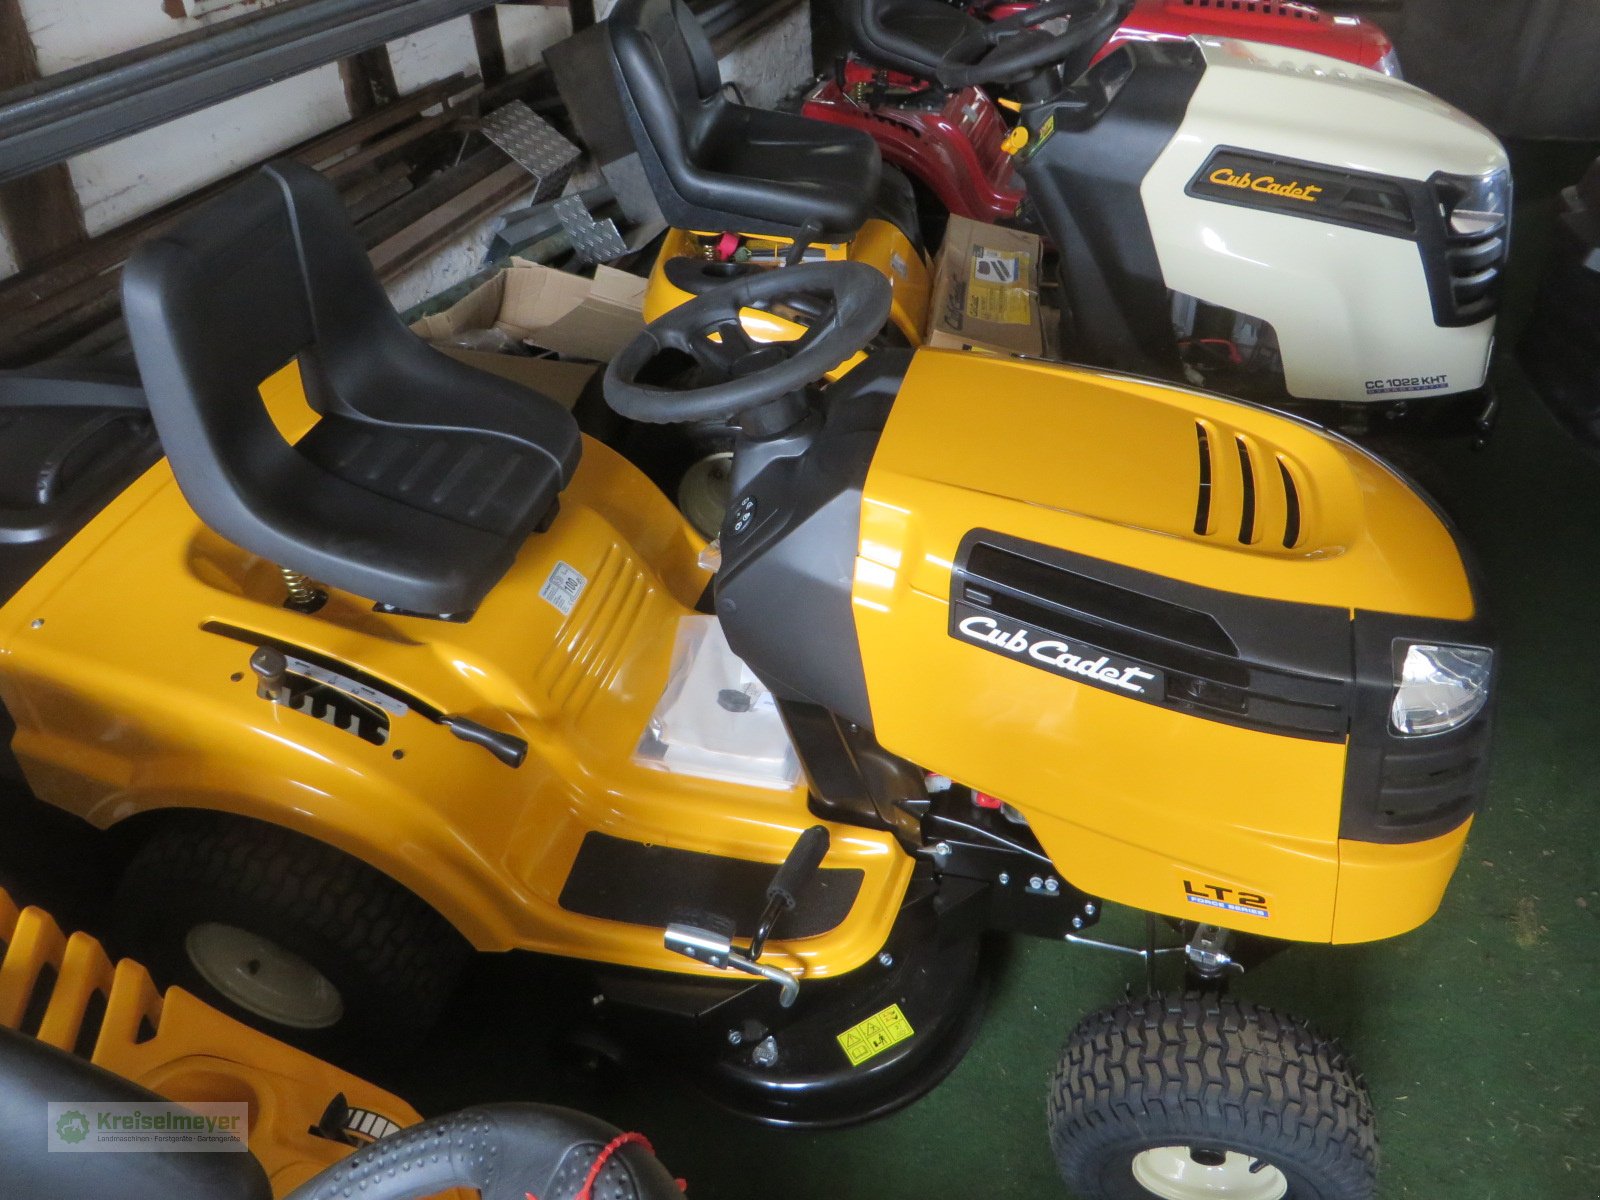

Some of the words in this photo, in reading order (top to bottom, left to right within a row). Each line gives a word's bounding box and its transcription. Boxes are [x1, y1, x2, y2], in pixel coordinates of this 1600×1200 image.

[1209, 167, 1251, 189] Cub
[1250, 176, 1323, 202] Cadet
[1365, 380, 1384, 389] CC
[1386, 377, 1420, 387] 1022
[1421, 375, 1447, 385] KHT
[564, 577, 578, 594] 100
[959, 616, 1028, 652] Cub
[1028, 640, 1155, 692] Cadet
[1190, 896, 1225, 909] FORCE
[1227, 904, 1266, 917] SERIES
